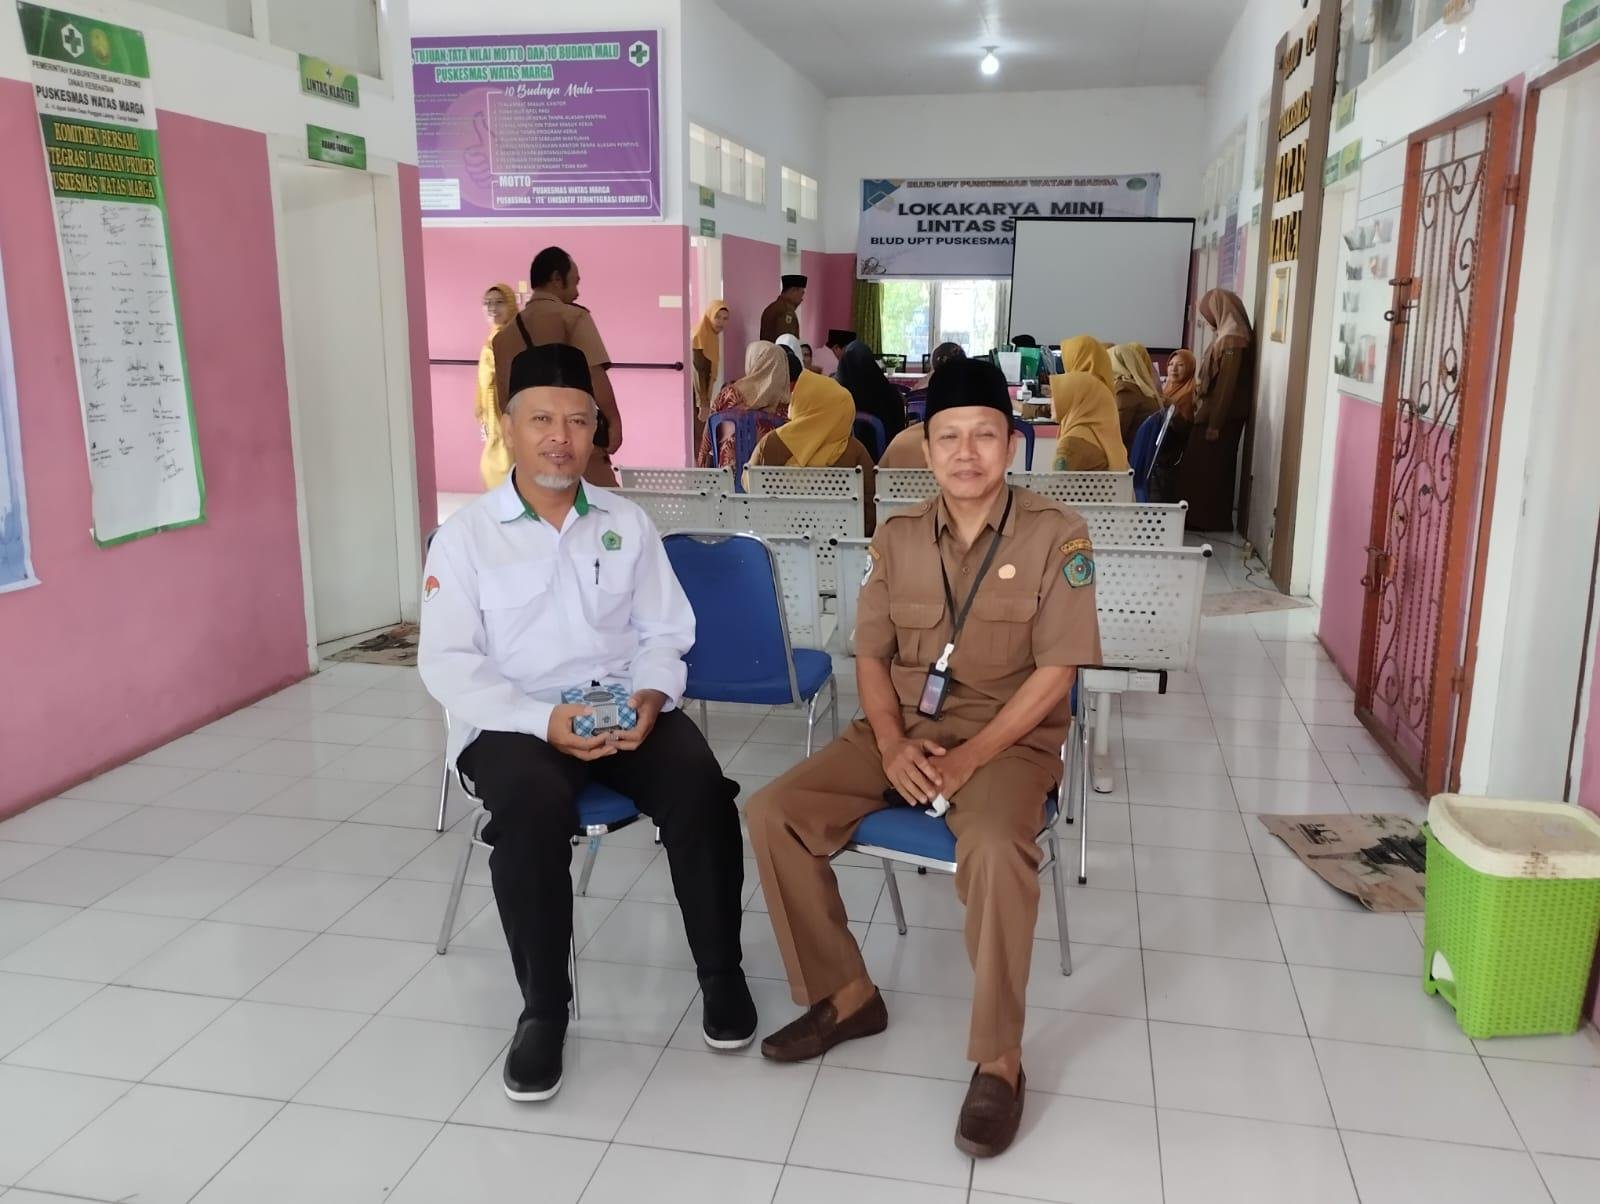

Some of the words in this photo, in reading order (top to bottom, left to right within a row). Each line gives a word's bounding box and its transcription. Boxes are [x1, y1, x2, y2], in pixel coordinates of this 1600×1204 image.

[469, 48, 491, 62] NILAI
[493, 47, 524, 61] MOTTO
[527, 46, 545, 60] DAN
[547, 46, 557, 60] 10
[559, 45, 593, 59] BUDAYA
[595, 43, 619, 58] MALU
[32, 60, 69, 74] PEMERINTAH
[69, 67, 100, 80] KABUPATEN
[436, 66, 488, 82] PUSKESMAS
[490, 66, 519, 80] WATAS
[521, 64, 553, 80] MARGA
[306, 78, 328, 96] LINTAS
[504, 87, 515, 97] 10
[517, 84, 560, 100] Budaya
[564, 82, 594, 97] Malu
[36, 85, 89, 105] PUSKESMAS
[90, 94, 117, 110] WATAS
[118, 100, 145, 115] MARGA
[54, 122, 101, 146] KOMITMEN
[102, 129, 139, 151] BERSAMA
[49, 147, 87, 170] TEGRASI
[88, 152, 125, 173] LAYANAN
[126, 156, 157, 176] PRIMER
[52, 172, 98, 193] USKESMAS
[98, 177, 127, 196] WATAS
[128, 179, 155, 198] MARGA
[499, 175, 532, 188] MOTTO
[532, 186, 567, 194] PUSKESMAS
[567, 186, 589, 194] WATAS
[589, 185, 610, 194] MARGA
[959, 179, 1028, 188] PUSKESMAS
[1029, 178, 1072, 187] WATAS
[1074, 177, 1119, 187] MARGA
[496, 196, 531, 204] PUSKESMAS
[898, 202, 1040, 216] LOKAKARYA
[1051, 201, 1104, 217] MINI
[916, 220, 996, 233] LINTAS
[1000, 220, 1014, 233] S
[870, 237, 904, 246] BLUD
[907, 237, 934, 246] UPT
